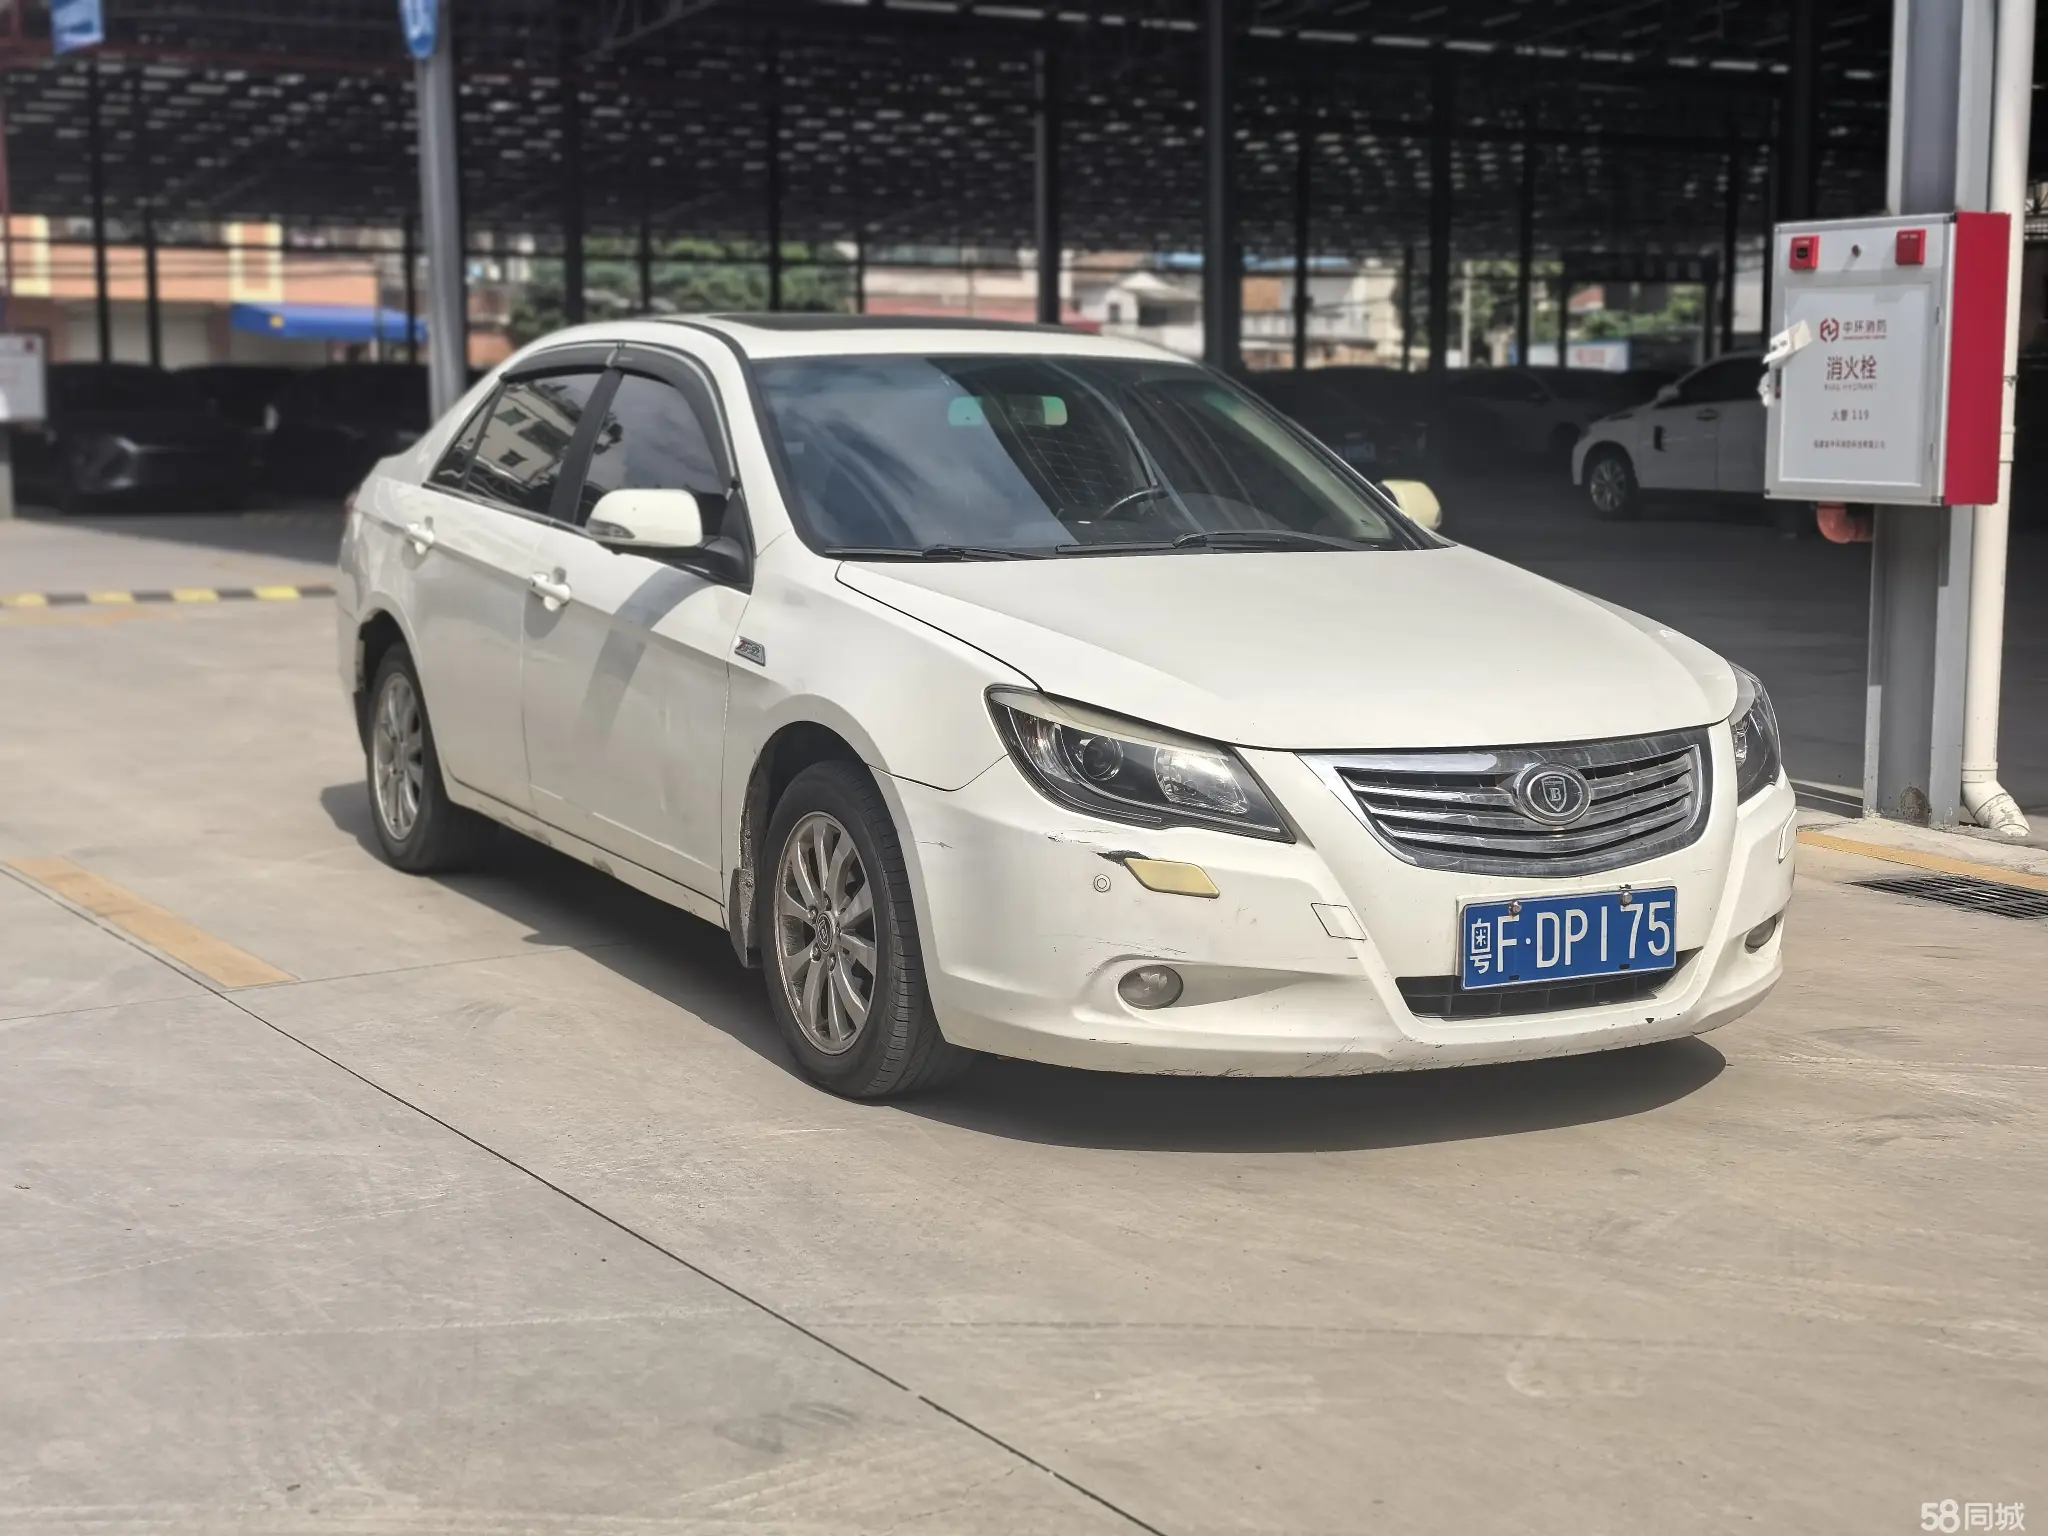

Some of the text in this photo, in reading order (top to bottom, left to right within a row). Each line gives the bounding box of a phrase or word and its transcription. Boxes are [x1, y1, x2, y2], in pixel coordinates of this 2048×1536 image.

[1826, 355, 1877, 380] 消火栓
[1852, 409, 1869, 421] 119
